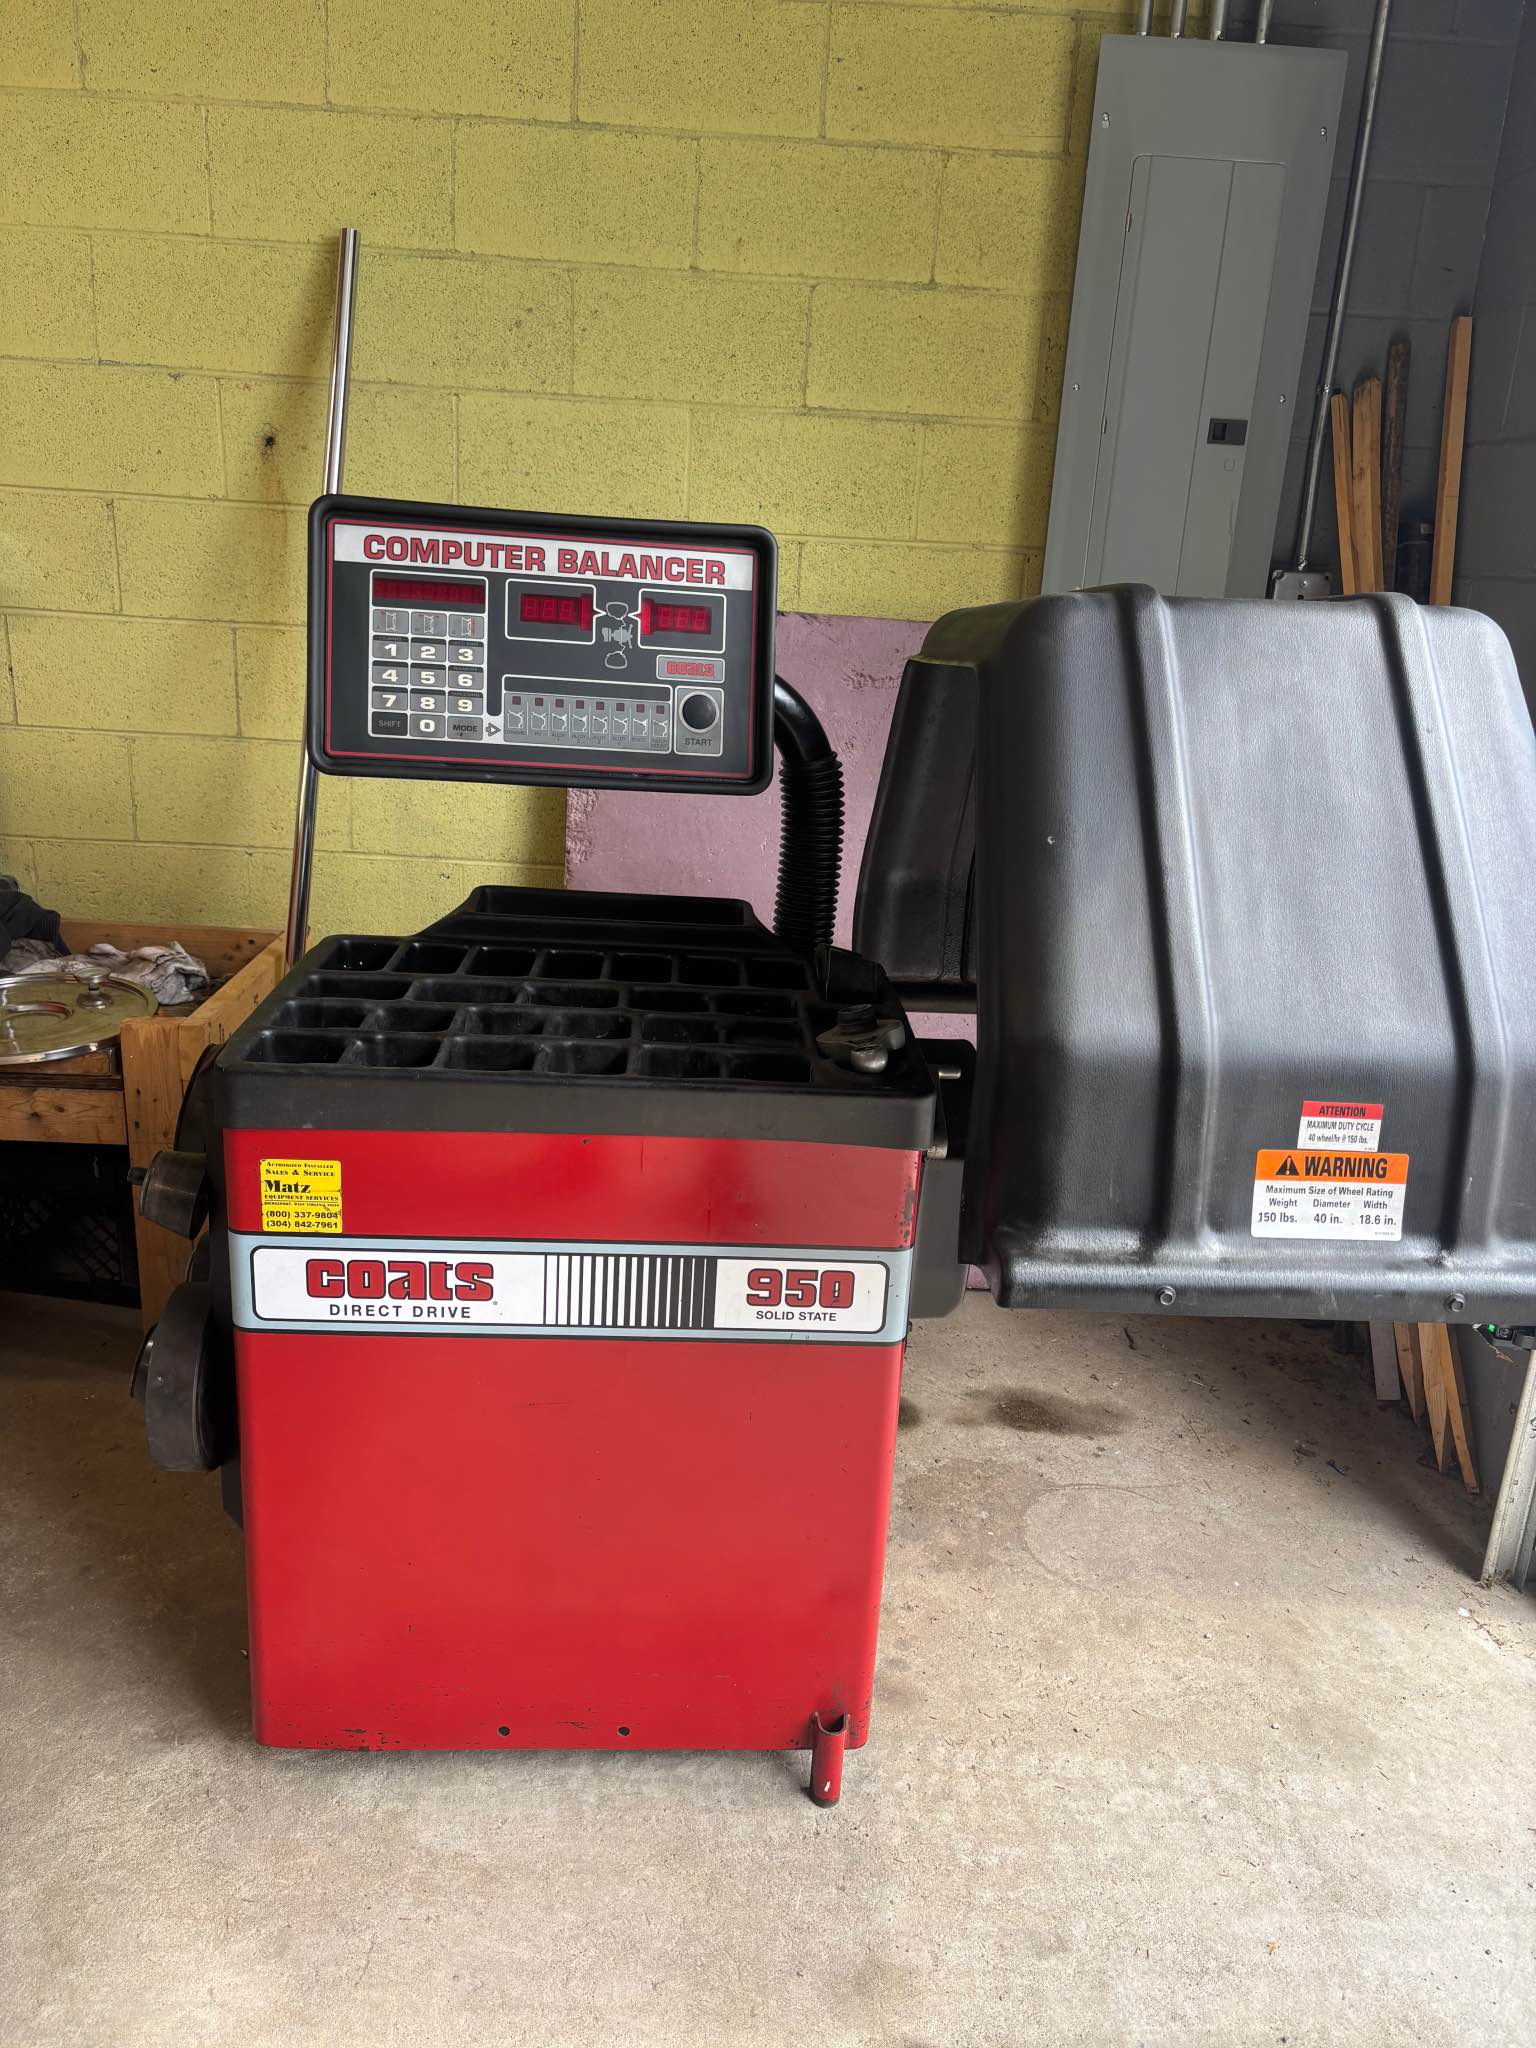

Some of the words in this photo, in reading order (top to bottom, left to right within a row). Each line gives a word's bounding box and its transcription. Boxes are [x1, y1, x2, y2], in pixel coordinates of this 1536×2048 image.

[363, 534, 546, 572] COMPUTER
[557, 548, 726, 585] BALANCER
[384, 643, 397, 656] 1
[420, 646, 436, 659] 2
[458, 648, 474, 662] 3
[382, 669, 398, 682] 4
[420, 672, 436, 684] 5
[458, 674, 473, 687] 6
[382, 694, 397, 708] 7
[420, 697, 436, 710] 8
[458, 699, 473, 712] 9
[379, 720, 400, 728] SHIFT
[420, 719, 436, 732] 0
[452, 724, 478, 732] MODE
[684, 738, 712, 747] START
[1319, 1105, 1366, 1117] ATTENTION
[1307, 1120, 1337, 1129] MAXIMUM
[1338, 1122, 1354, 1131] DUTY
[1356, 1123, 1374, 1132] CYCLE
[1308, 1134, 1315, 1142] 40
[1348, 1135, 1357, 1143] 150
[1304, 1156, 1388, 1178] WARNING
[264, 1180, 311, 1193] Matz
[1266, 1184, 1306, 1194] Maximum
[1308, 1186, 1325, 1194] Size
[1328, 1186, 1337, 1195] of
[1339, 1187, 1364, 1196] Wheel
[1366, 1188, 1393, 1198] Rating
[1269, 1198, 1297, 1208] Weight
[1313, 1199, 1351, 1208] Diameter
[1364, 1200, 1388, 1209] Width
[294, 1211, 338, 1219] 337-9804
[1258, 1212, 1276, 1222] 150
[1280, 1212, 1297, 1223] lbs.
[1314, 1213, 1327, 1223] 40
[1330, 1213, 1342, 1224] in.
[1360, 1214, 1381, 1225] 18.6
[1384, 1214, 1396, 1226] in.
[267, 1220, 291, 1228] (304)
[746, 1268, 856, 1309] 950
[329, 1304, 402, 1317] DIRECT
[412, 1306, 471, 1318] DRIVE
[756, 1310, 794, 1320] SOLID
[798, 1312, 837, 1321] STATE
